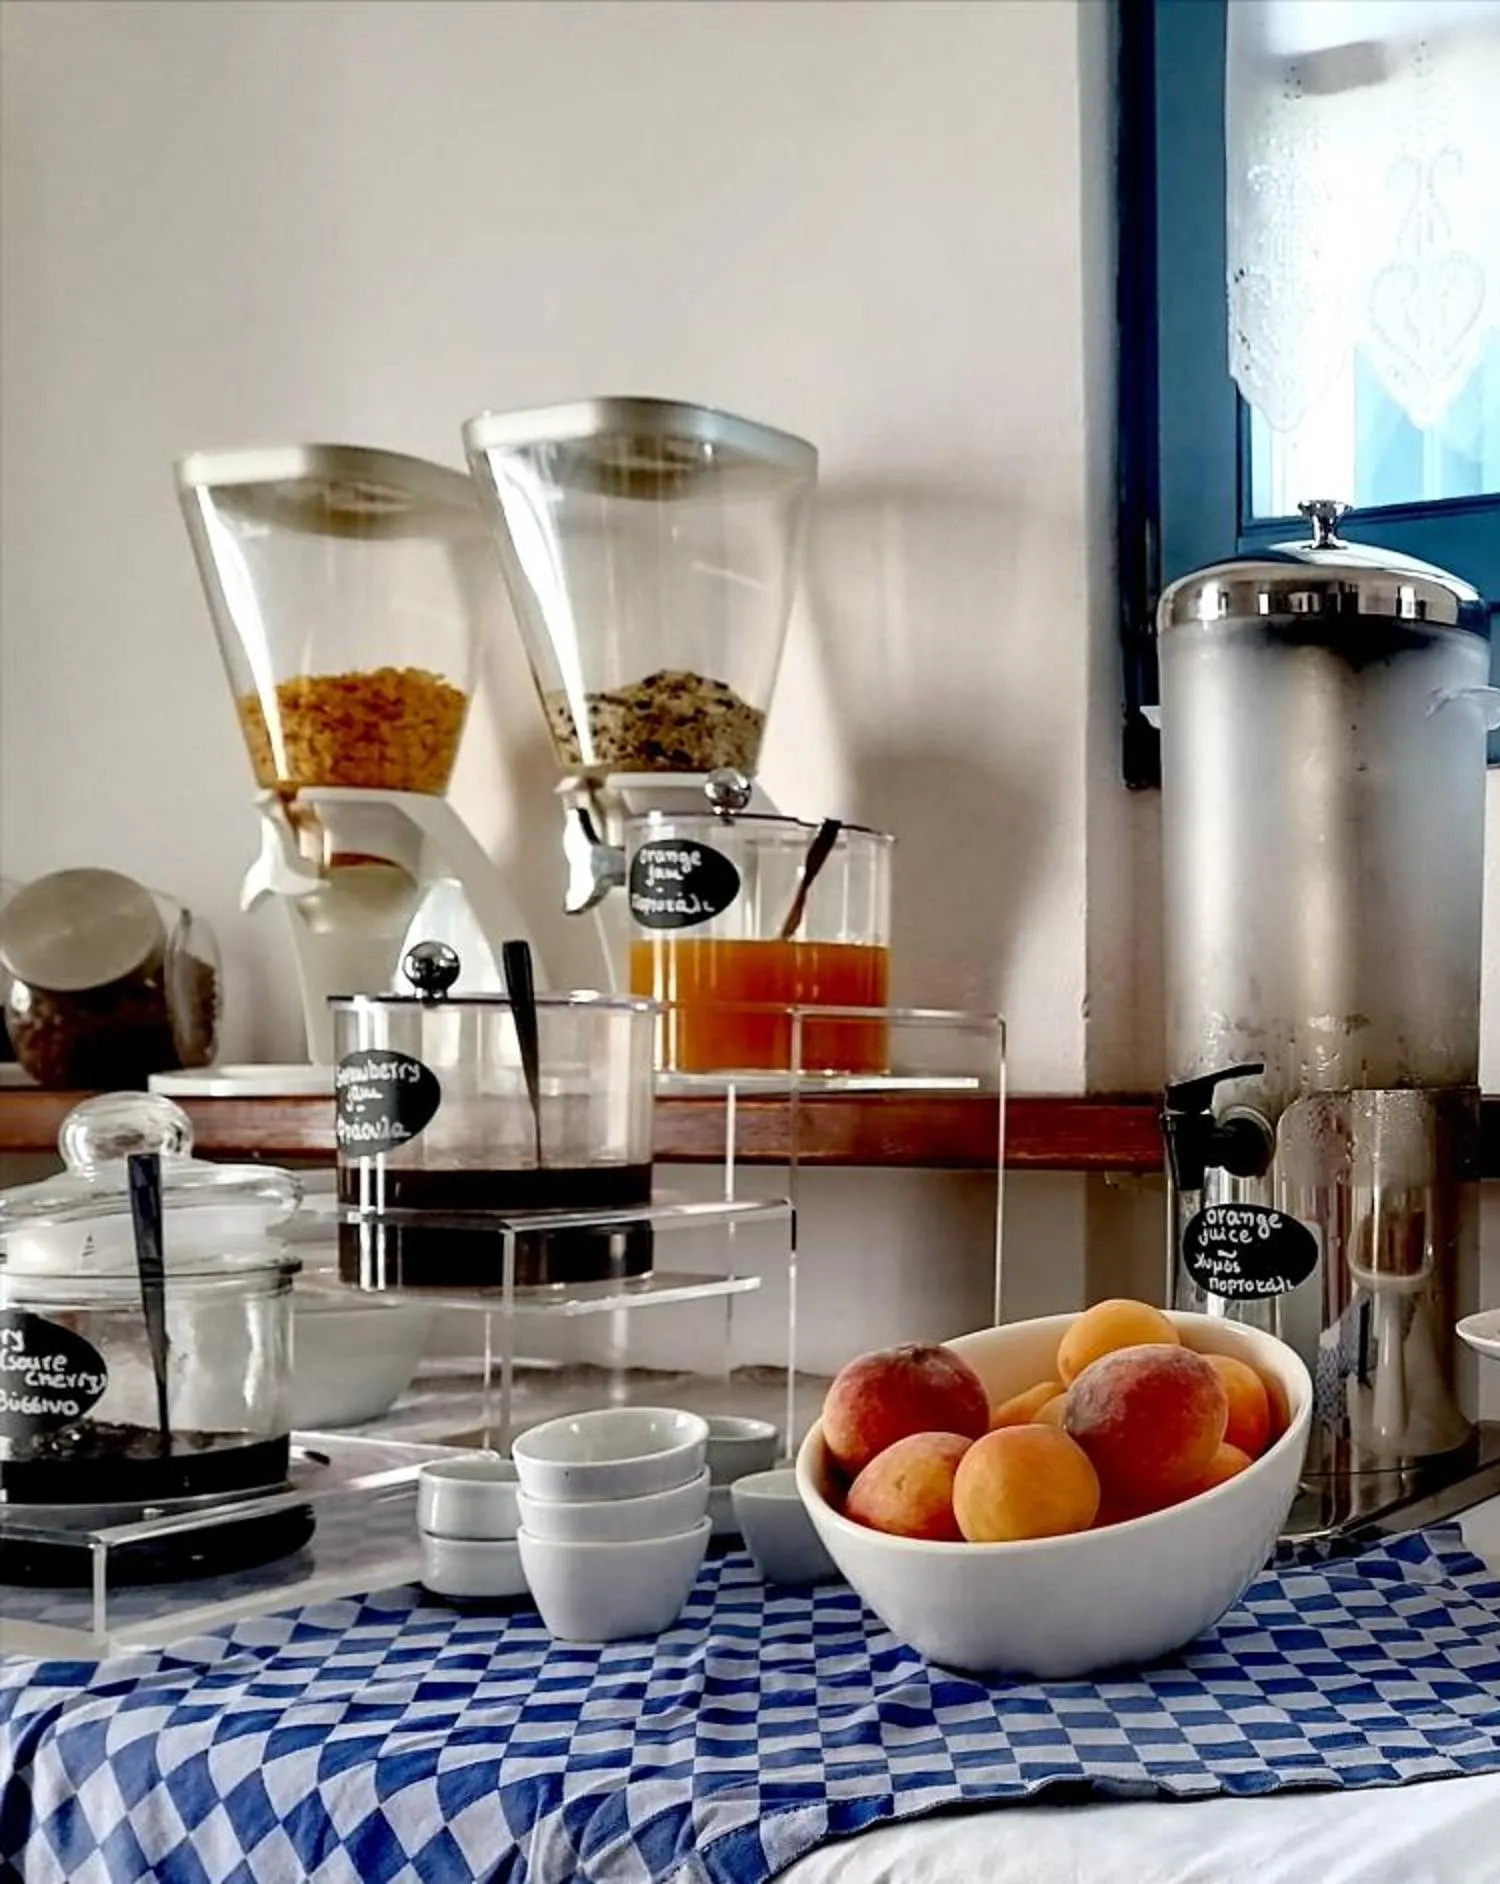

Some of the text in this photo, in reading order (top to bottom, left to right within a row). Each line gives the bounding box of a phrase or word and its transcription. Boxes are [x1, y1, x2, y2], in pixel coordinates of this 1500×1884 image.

[640, 847, 702, 873] orange
[1197, 1222, 1253, 1246] juice
[1206, 1208, 1283, 1239] orange
